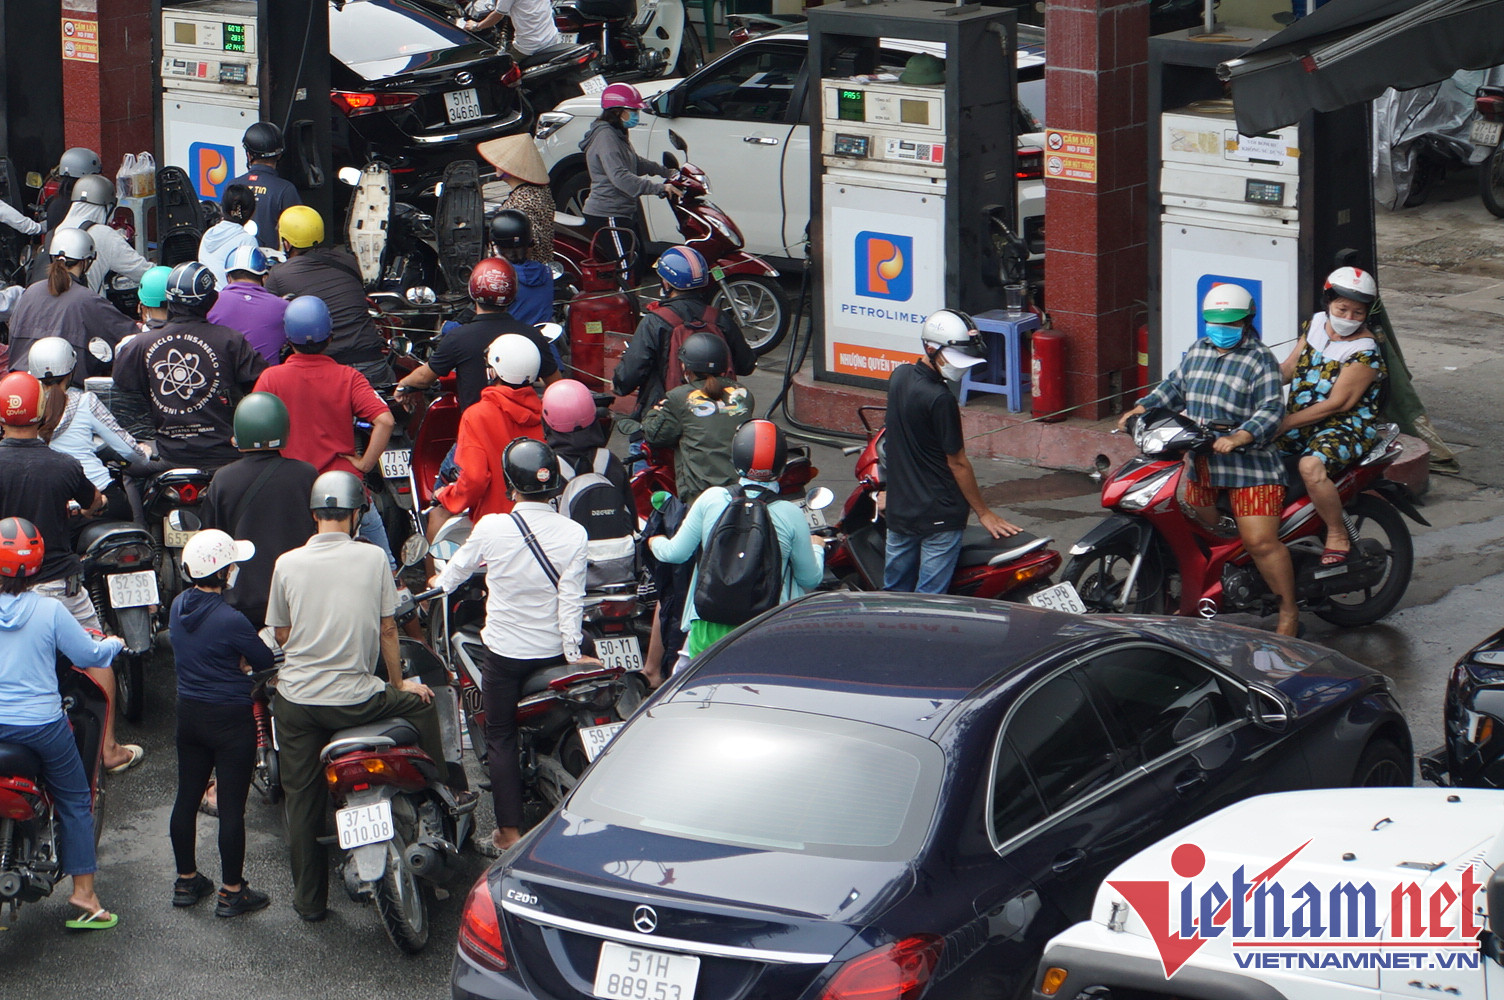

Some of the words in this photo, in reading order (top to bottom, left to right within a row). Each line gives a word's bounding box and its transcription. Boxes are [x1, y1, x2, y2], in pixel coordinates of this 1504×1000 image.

[453, 91, 471, 106] 51H
[449, 104, 480, 121] 346.60
[1075, 146, 1090, 155] FIRE
[841, 304, 927, 325] PETROLIMEX
[840, 352, 867, 371] NHƯỢNG
[115, 574, 149, 590] 52-S6
[117, 589, 151, 605] 3733
[600, 639, 632, 656] 50-Y1
[345, 805, 384, 827] 37-L1
[343, 821, 389, 845] 010.08
[507, 889, 538, 905] C200
[628, 951, 669, 978] 51H
[607, 974, 682, 1000] 889.53
